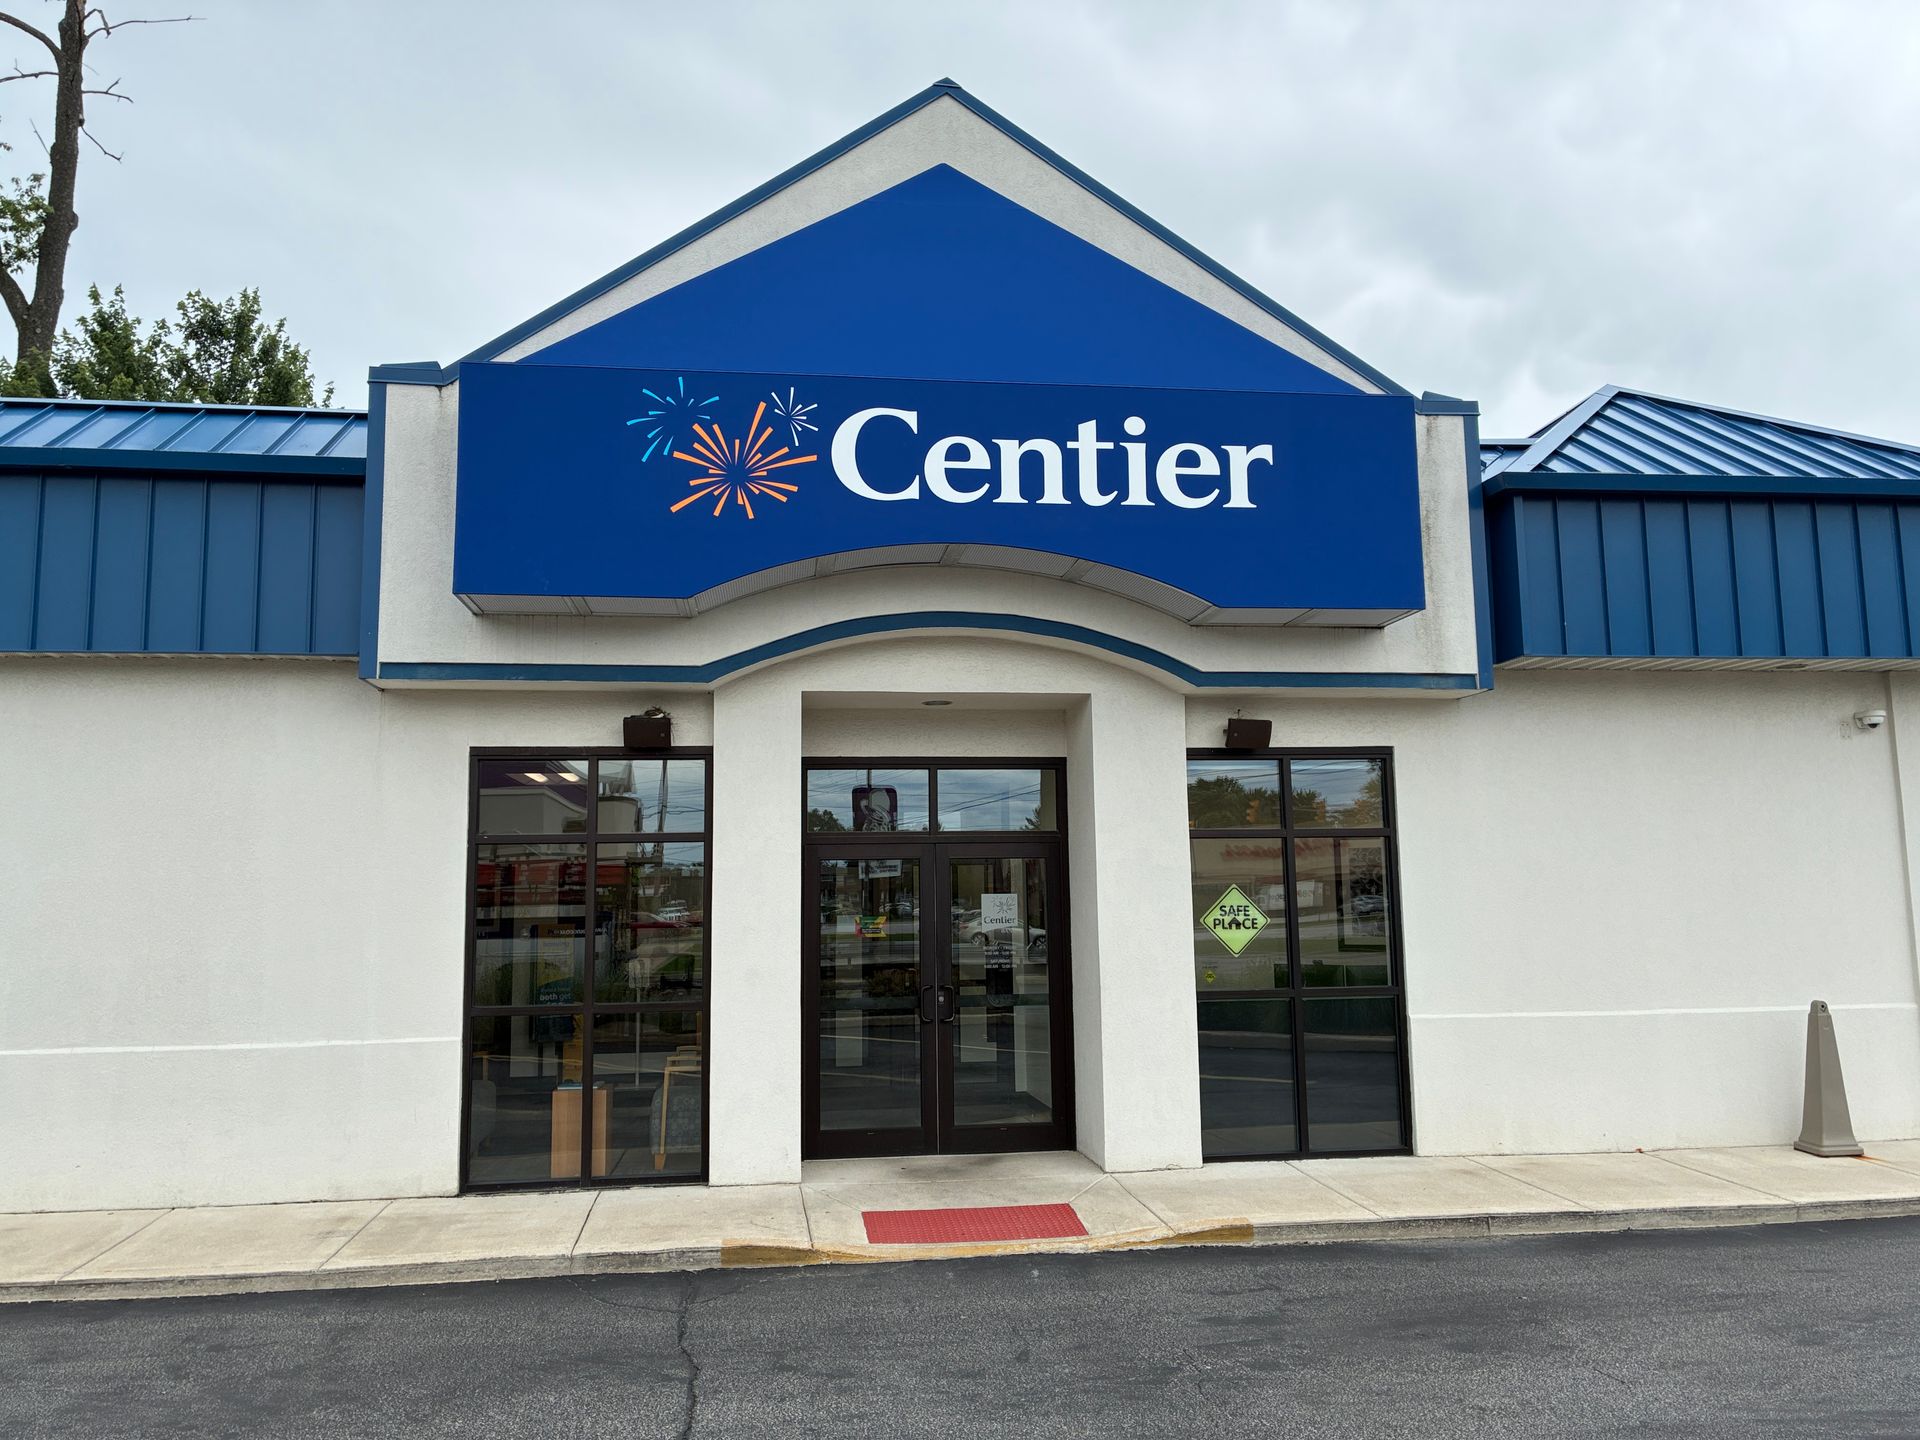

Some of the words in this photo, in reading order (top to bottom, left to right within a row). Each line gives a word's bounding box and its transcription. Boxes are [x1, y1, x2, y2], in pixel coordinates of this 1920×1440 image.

[830, 407, 1273, 509] Centier
[1219, 904, 1251, 917] SAFE
[984, 916, 1016, 924] Centier
